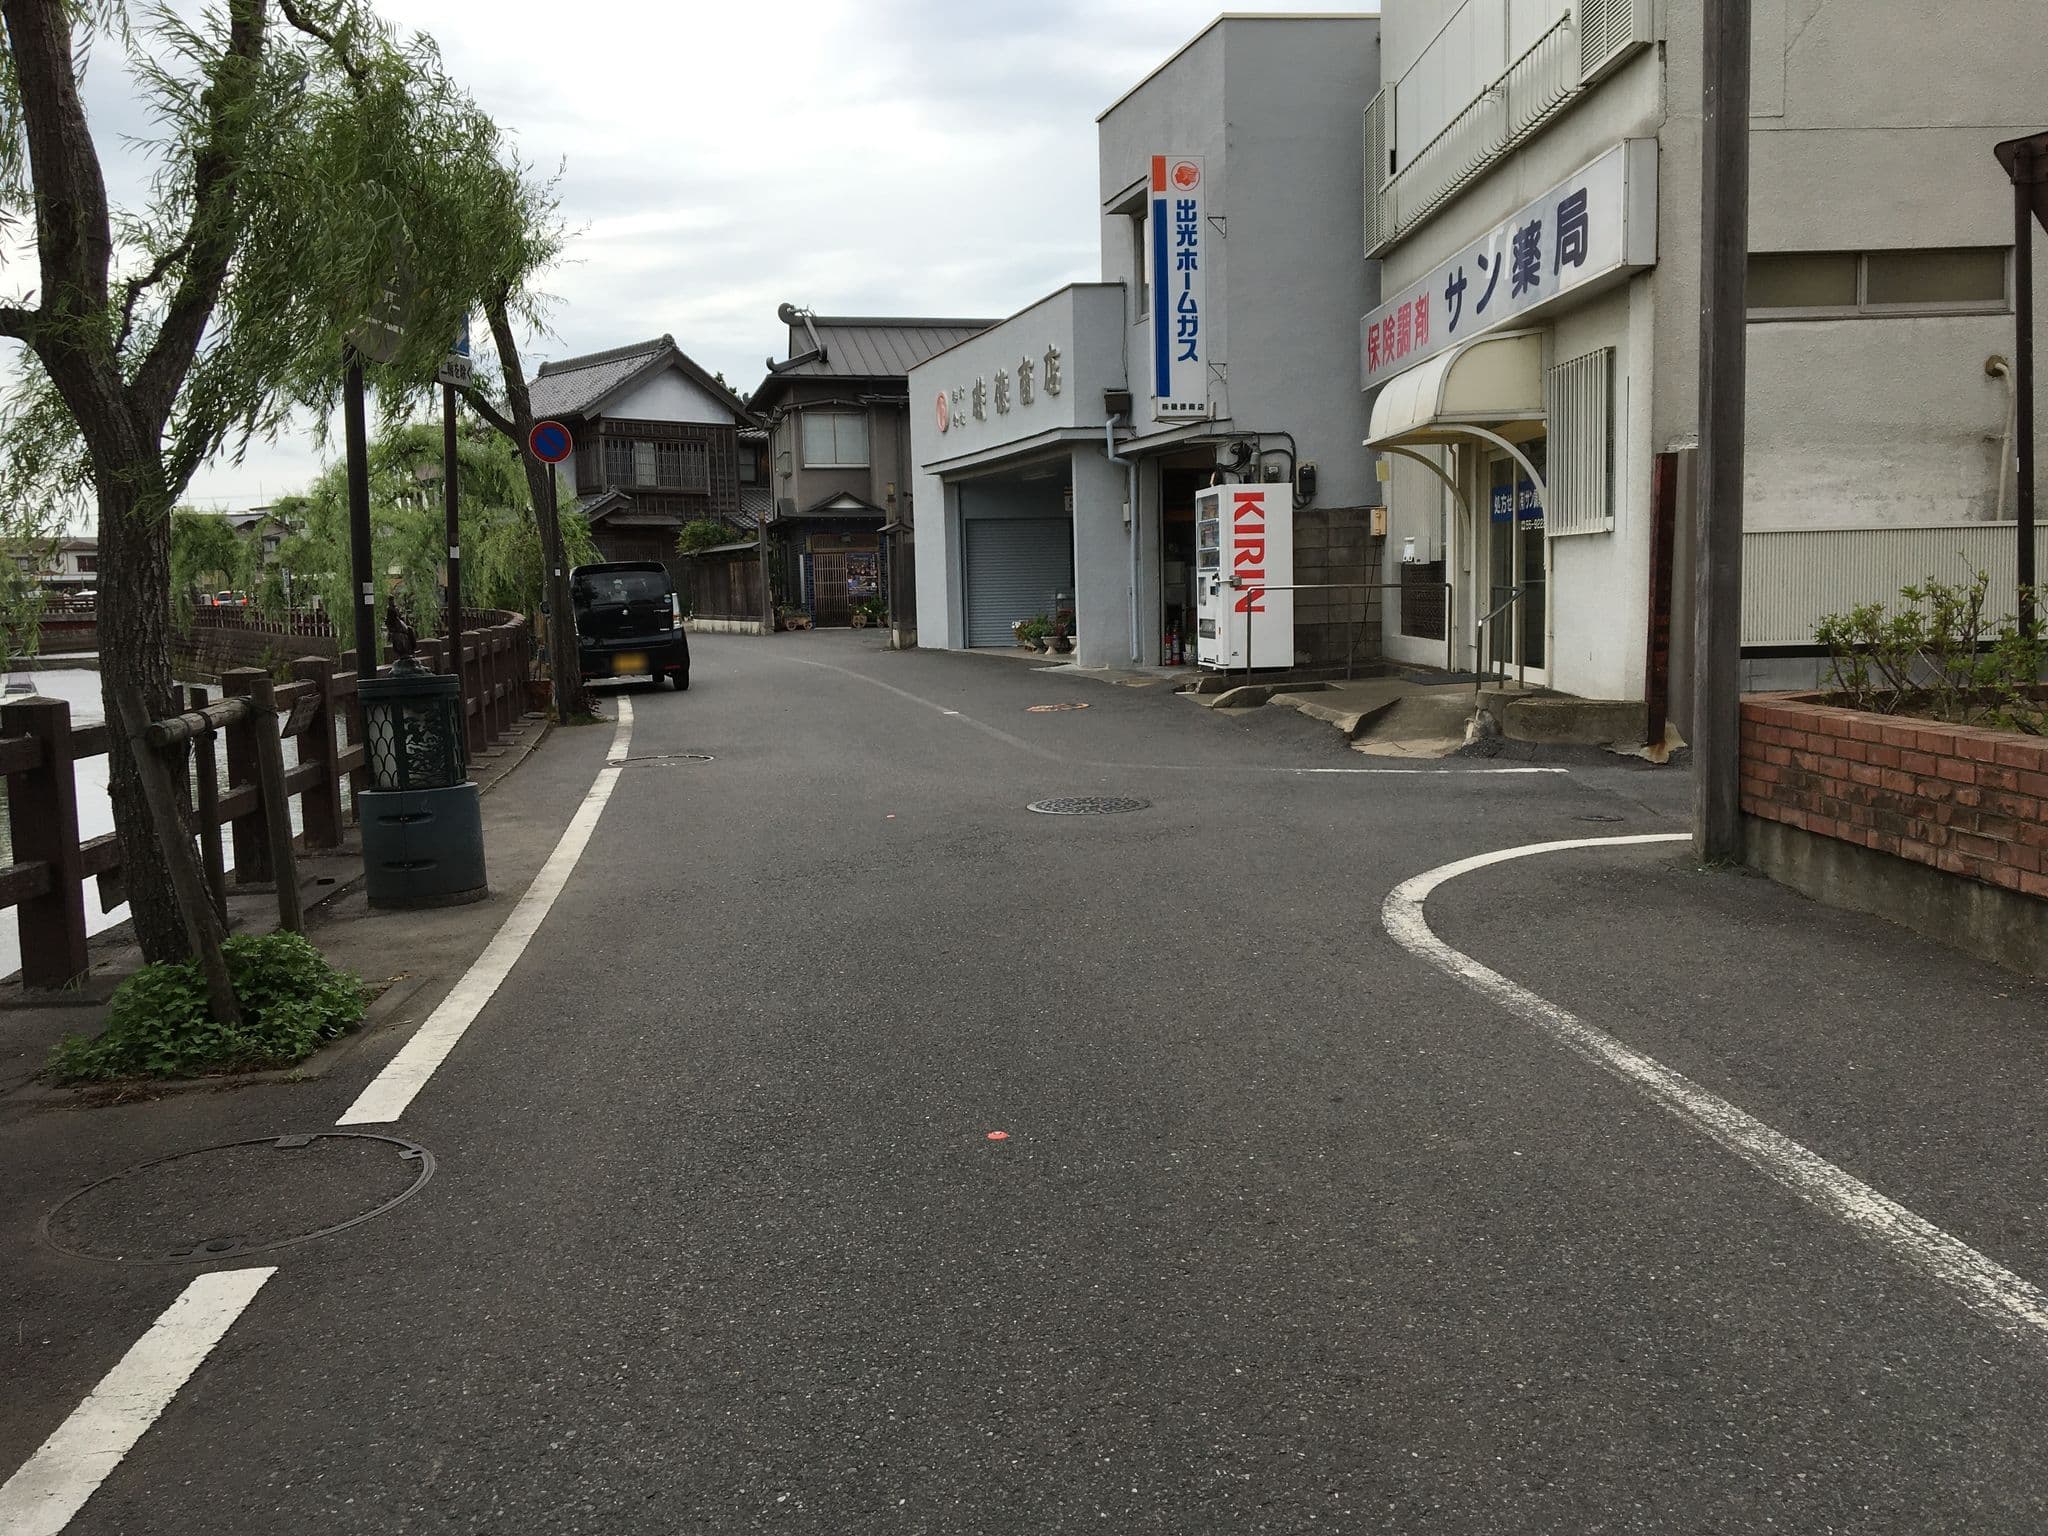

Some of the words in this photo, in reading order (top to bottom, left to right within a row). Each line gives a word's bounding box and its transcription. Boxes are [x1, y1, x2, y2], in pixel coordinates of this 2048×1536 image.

[1176, 199, 1199, 362] 出光ホームガス
[1445, 187, 1589, 333] サン薬局
[1367, 292, 1430, 374] 保険調剤
[1234, 492, 1265, 612] KIRIN
